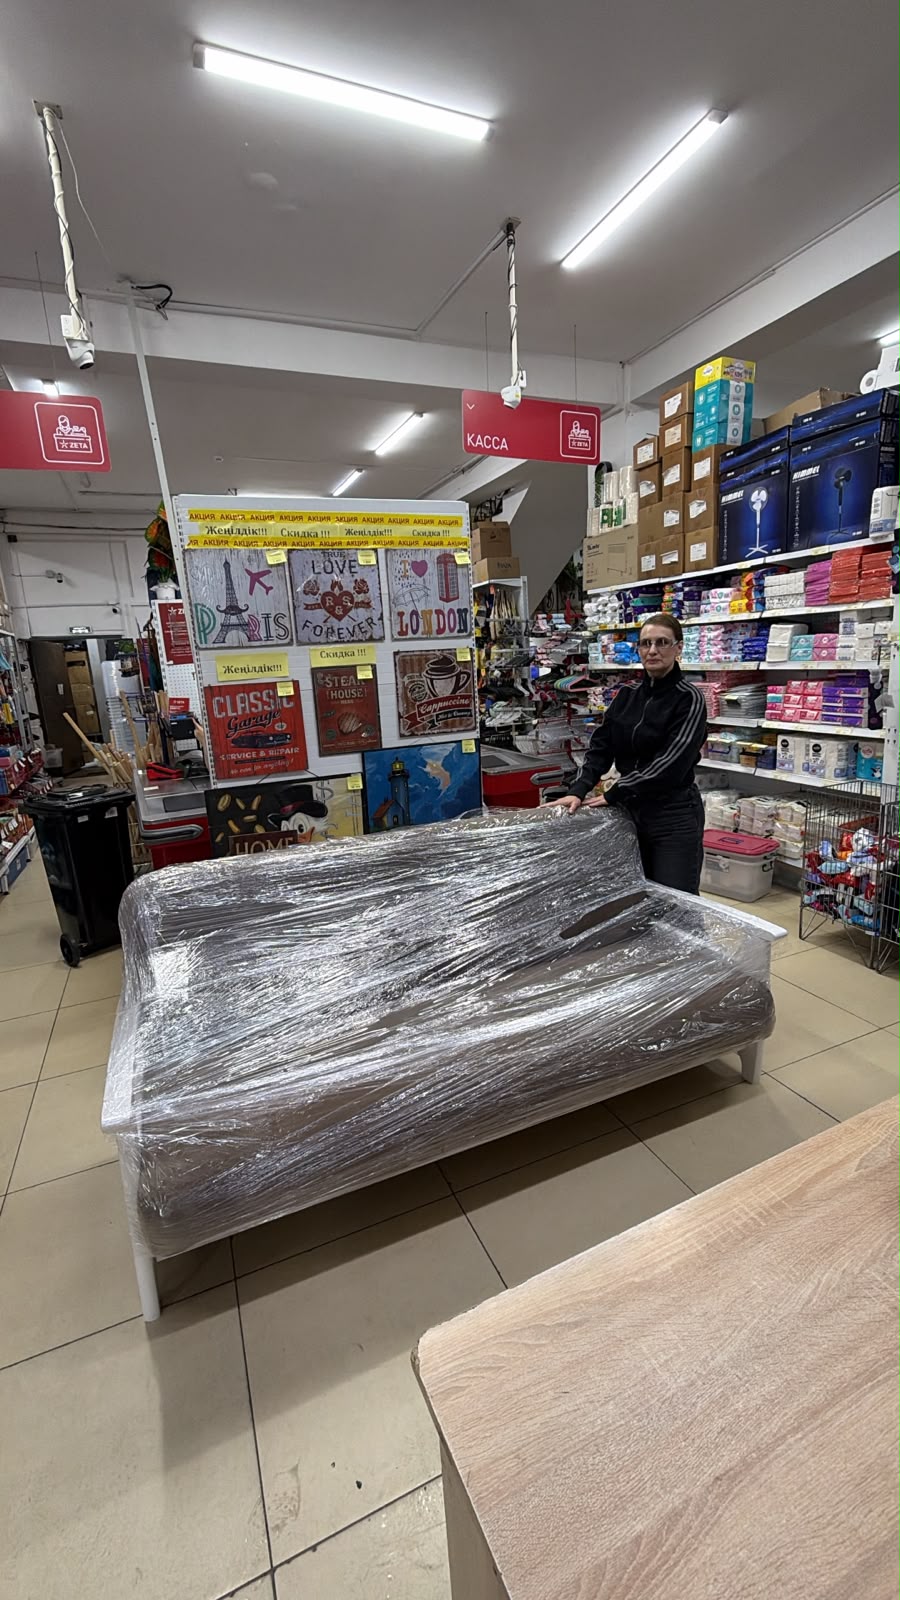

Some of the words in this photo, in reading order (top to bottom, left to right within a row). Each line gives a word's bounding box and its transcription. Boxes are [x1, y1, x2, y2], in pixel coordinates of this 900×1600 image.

[466, 433, 509, 450] КАССА
[280, 528, 319, 538] Скидка
[412, 529, 441, 538] Скидка
[311, 559, 358, 575] LOVE
[325, 596, 334, 606] R
[335, 605, 343, 615] &
[302, 617, 377, 640] FOREVER
[397, 607, 469, 636] LONDON
[319, 649, 355, 659] Скидка
[223, 664, 282, 675] Жеңілдік!!!
[330, 688, 364, 700] HOUSE
[212, 688, 295, 719] CLASSIC
[418, 696, 470, 714] Cappuccino
[226, 709, 281, 738] Garage
[219, 751, 257, 761] SERVICE
[268, 747, 300, 756] REPAIR
